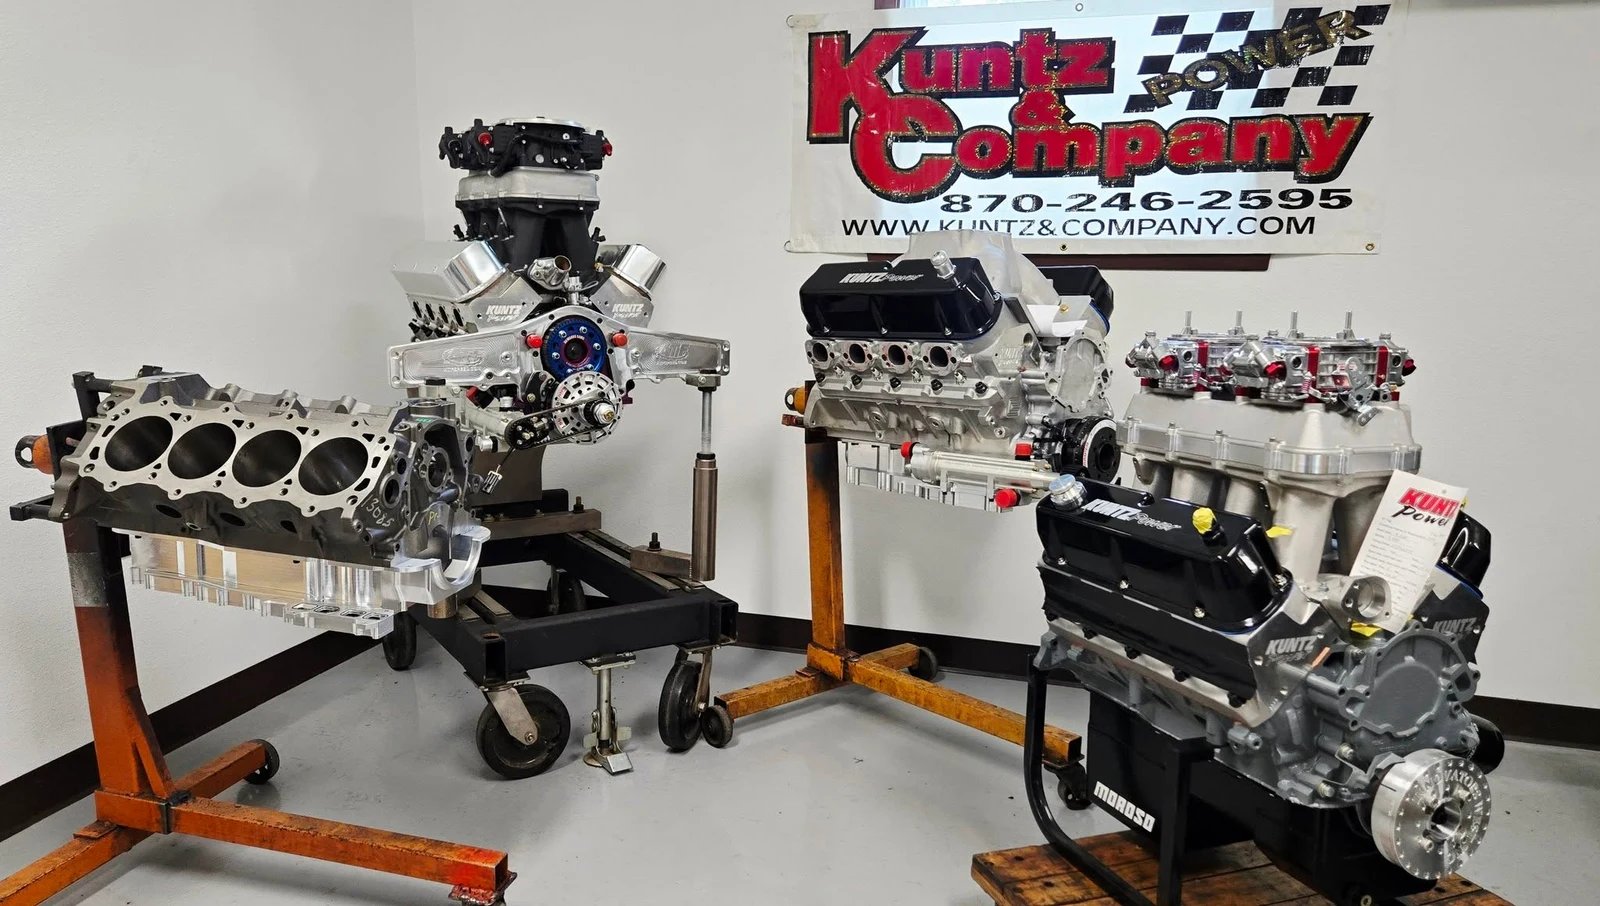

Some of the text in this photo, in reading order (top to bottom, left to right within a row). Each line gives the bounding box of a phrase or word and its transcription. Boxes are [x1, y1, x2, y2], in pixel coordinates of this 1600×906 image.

[1141, 9, 1373, 109] POWER
[806, 26, 1116, 144] Kuntz
[1008, 88, 1076, 128] &
[850, 93, 1374, 204] Company
[940, 188, 1353, 213] 870-246-2595
[842, 216, 1315, 236] WWWKUNTZ&COMPANY.COM
[839, 272, 888, 283] KUNTZ
[485, 304, 522, 315] KUNTZ
[611, 303, 644, 313] KUNTZ
[1081, 498, 1142, 521] KUNTZ
[1398, 487, 1460, 519] KUNT
[1432, 617, 1478, 633] KUNTZ
[1265, 636, 1317, 655] KUNTZ
[1093, 781, 1156, 833] MOROSO
